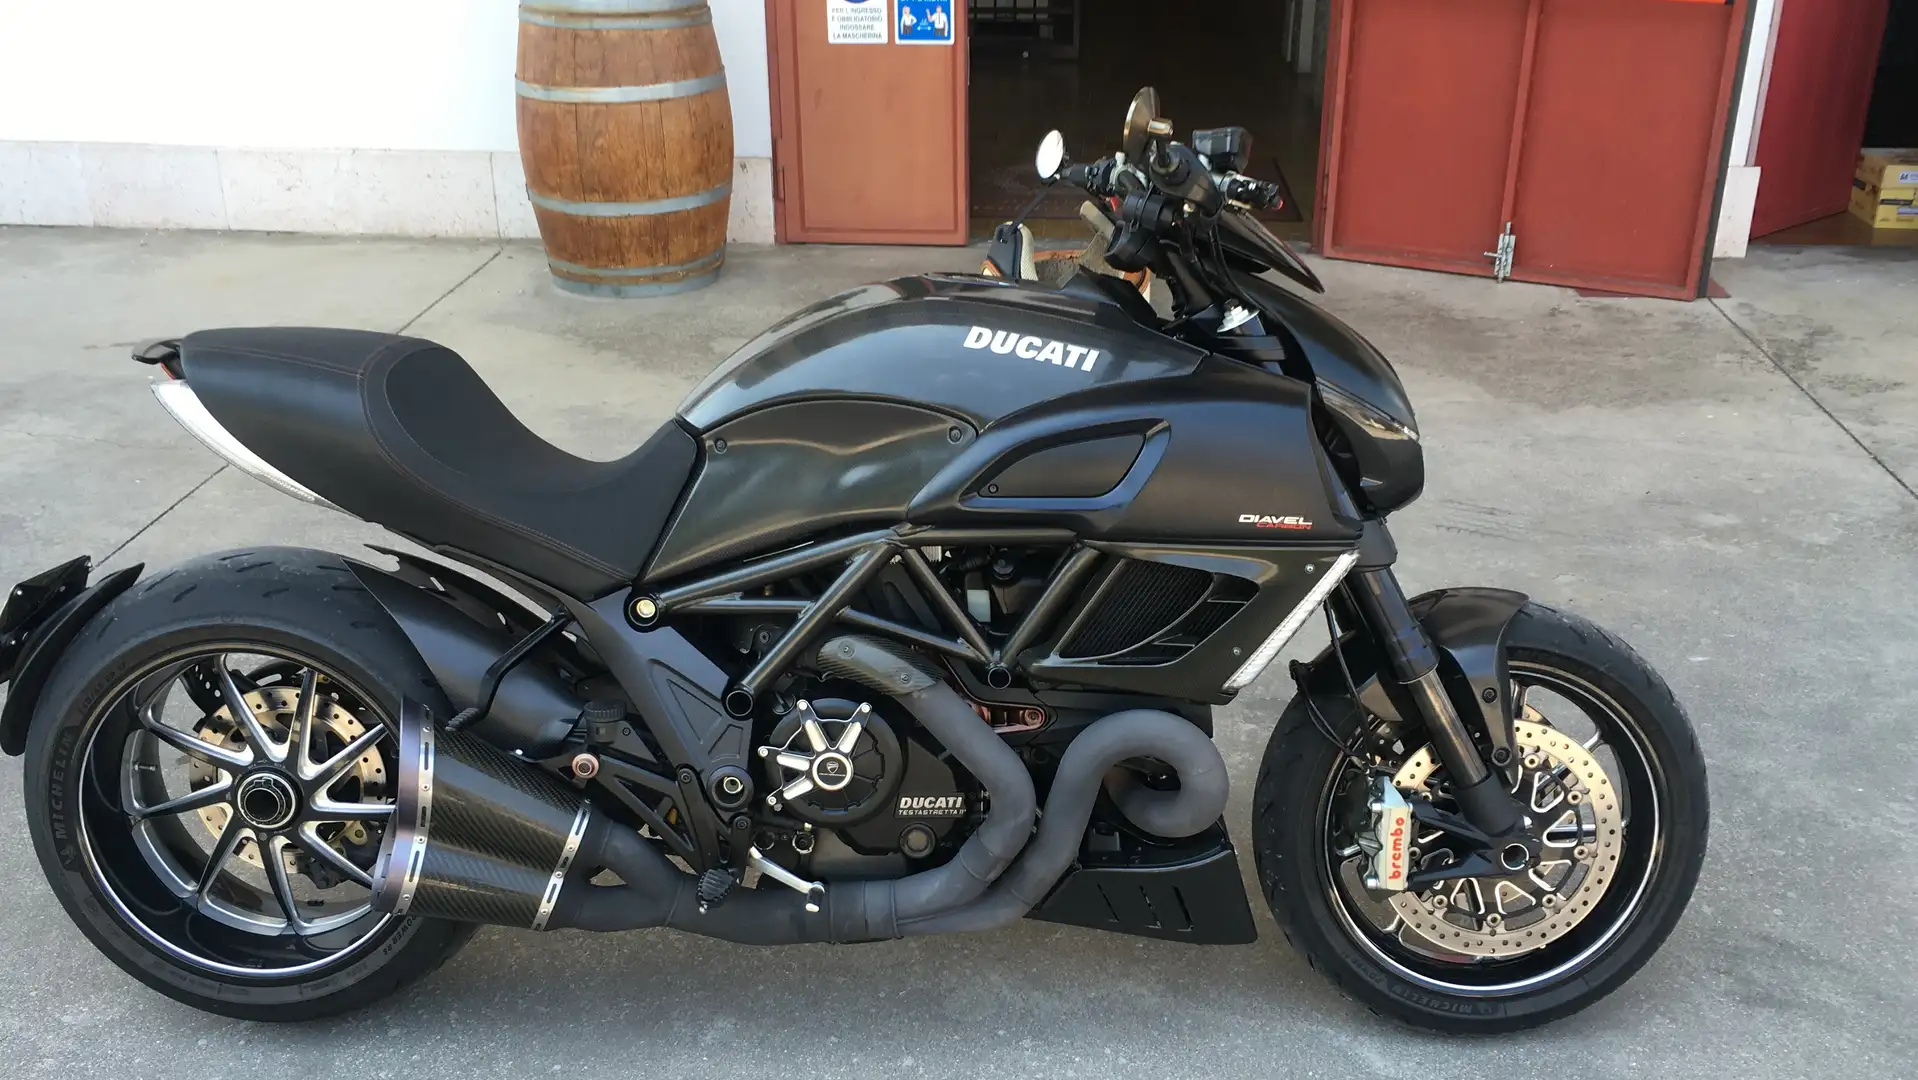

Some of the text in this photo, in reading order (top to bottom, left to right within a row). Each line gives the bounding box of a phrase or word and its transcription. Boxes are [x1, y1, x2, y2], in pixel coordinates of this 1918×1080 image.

[832, 31, 883, 40] LA MASCHERINA
[963, 325, 1100, 372] DUCATI
[1238, 514, 1313, 525] DIAVEL
[1256, 522, 1313, 530] CARBON
[51, 731, 76, 839] MICHELIN
[899, 796, 963, 809] DUCATI
[1388, 817, 1405, 880] brembo
[1392, 984, 1473, 1014] MICHELIN
